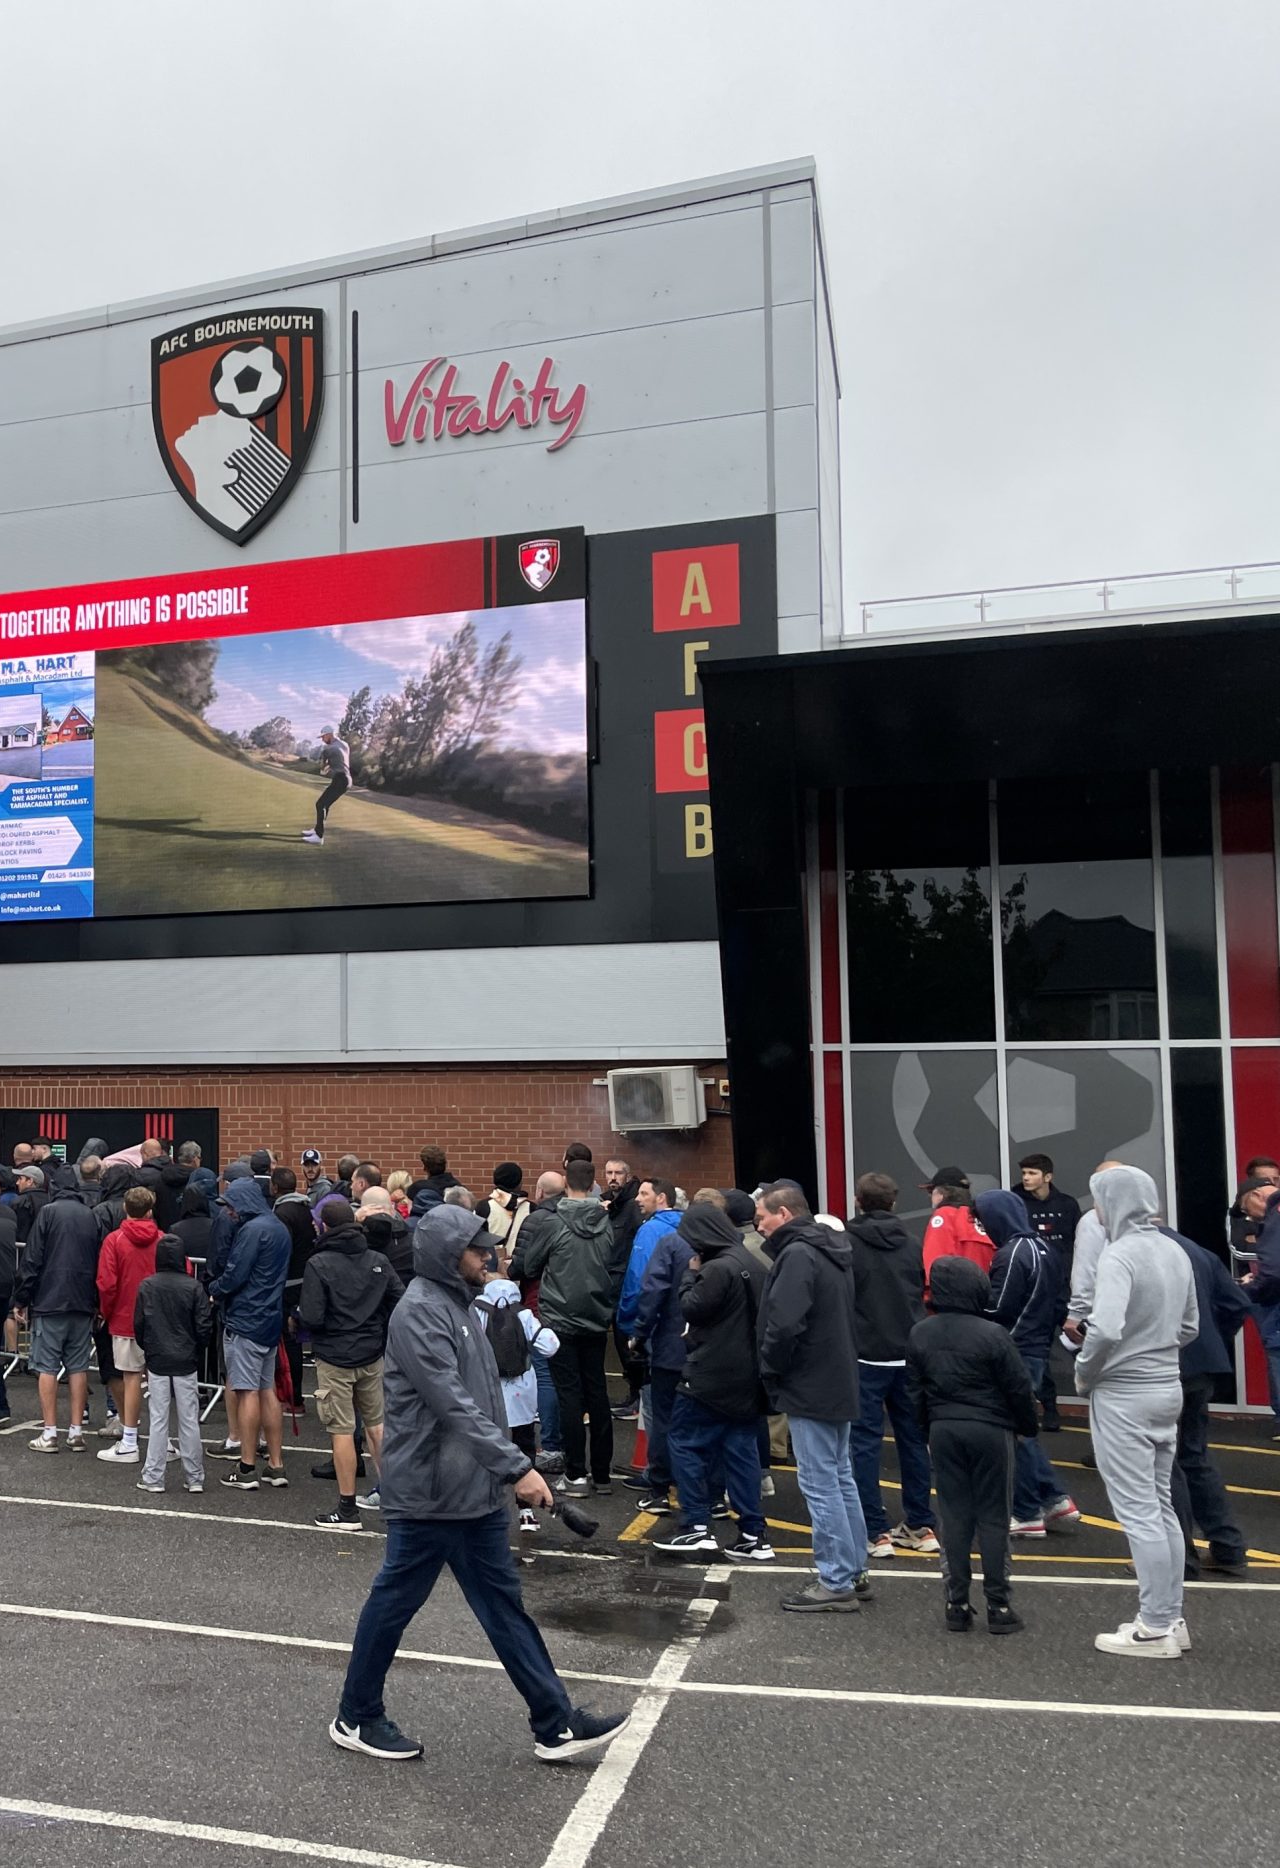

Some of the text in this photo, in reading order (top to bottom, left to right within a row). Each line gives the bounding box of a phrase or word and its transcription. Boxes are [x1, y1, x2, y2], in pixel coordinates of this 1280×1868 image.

[159, 315, 314, 356] AFC BOURNEMOUTH
[384, 356, 587, 452] Vitality
[0, 586, 249, 639] TOGETHER ANYTHING IS POSSIBLE
[1, 655, 77, 675] M.A. HART
[32, 671, 69, 681] Macadam
[70, 670, 83, 678] Ltd
[25, 786, 51, 794] SOUTH'S
[52, 784, 79, 792] NUMBER
[10, 798, 90, 809] TARMACADAM SPECIALIST.
[25, 793, 53, 801] ASPHALT
